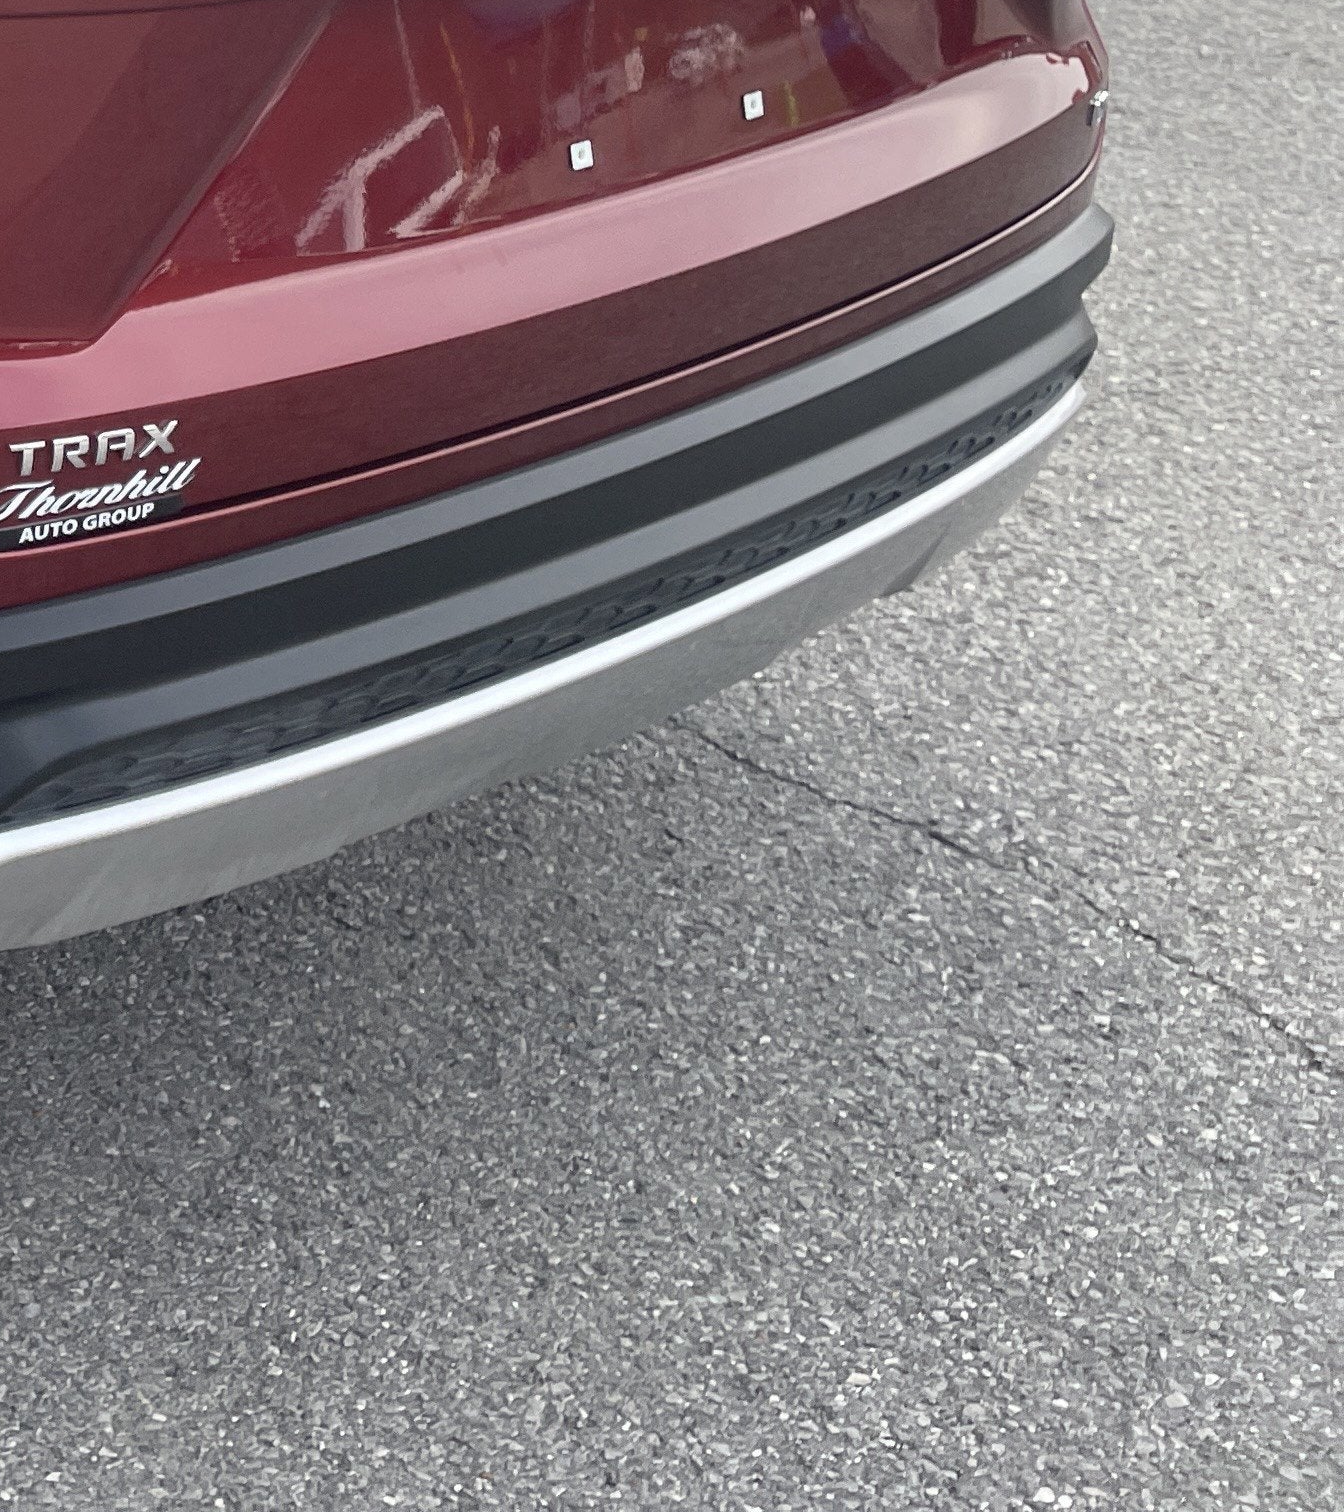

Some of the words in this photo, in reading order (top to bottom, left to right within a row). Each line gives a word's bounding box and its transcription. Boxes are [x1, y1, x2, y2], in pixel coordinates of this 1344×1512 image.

[9, 420, 179, 476] TRAX
[18, 519, 79, 544] AUTO
[82, 502, 155, 531] GROUP
